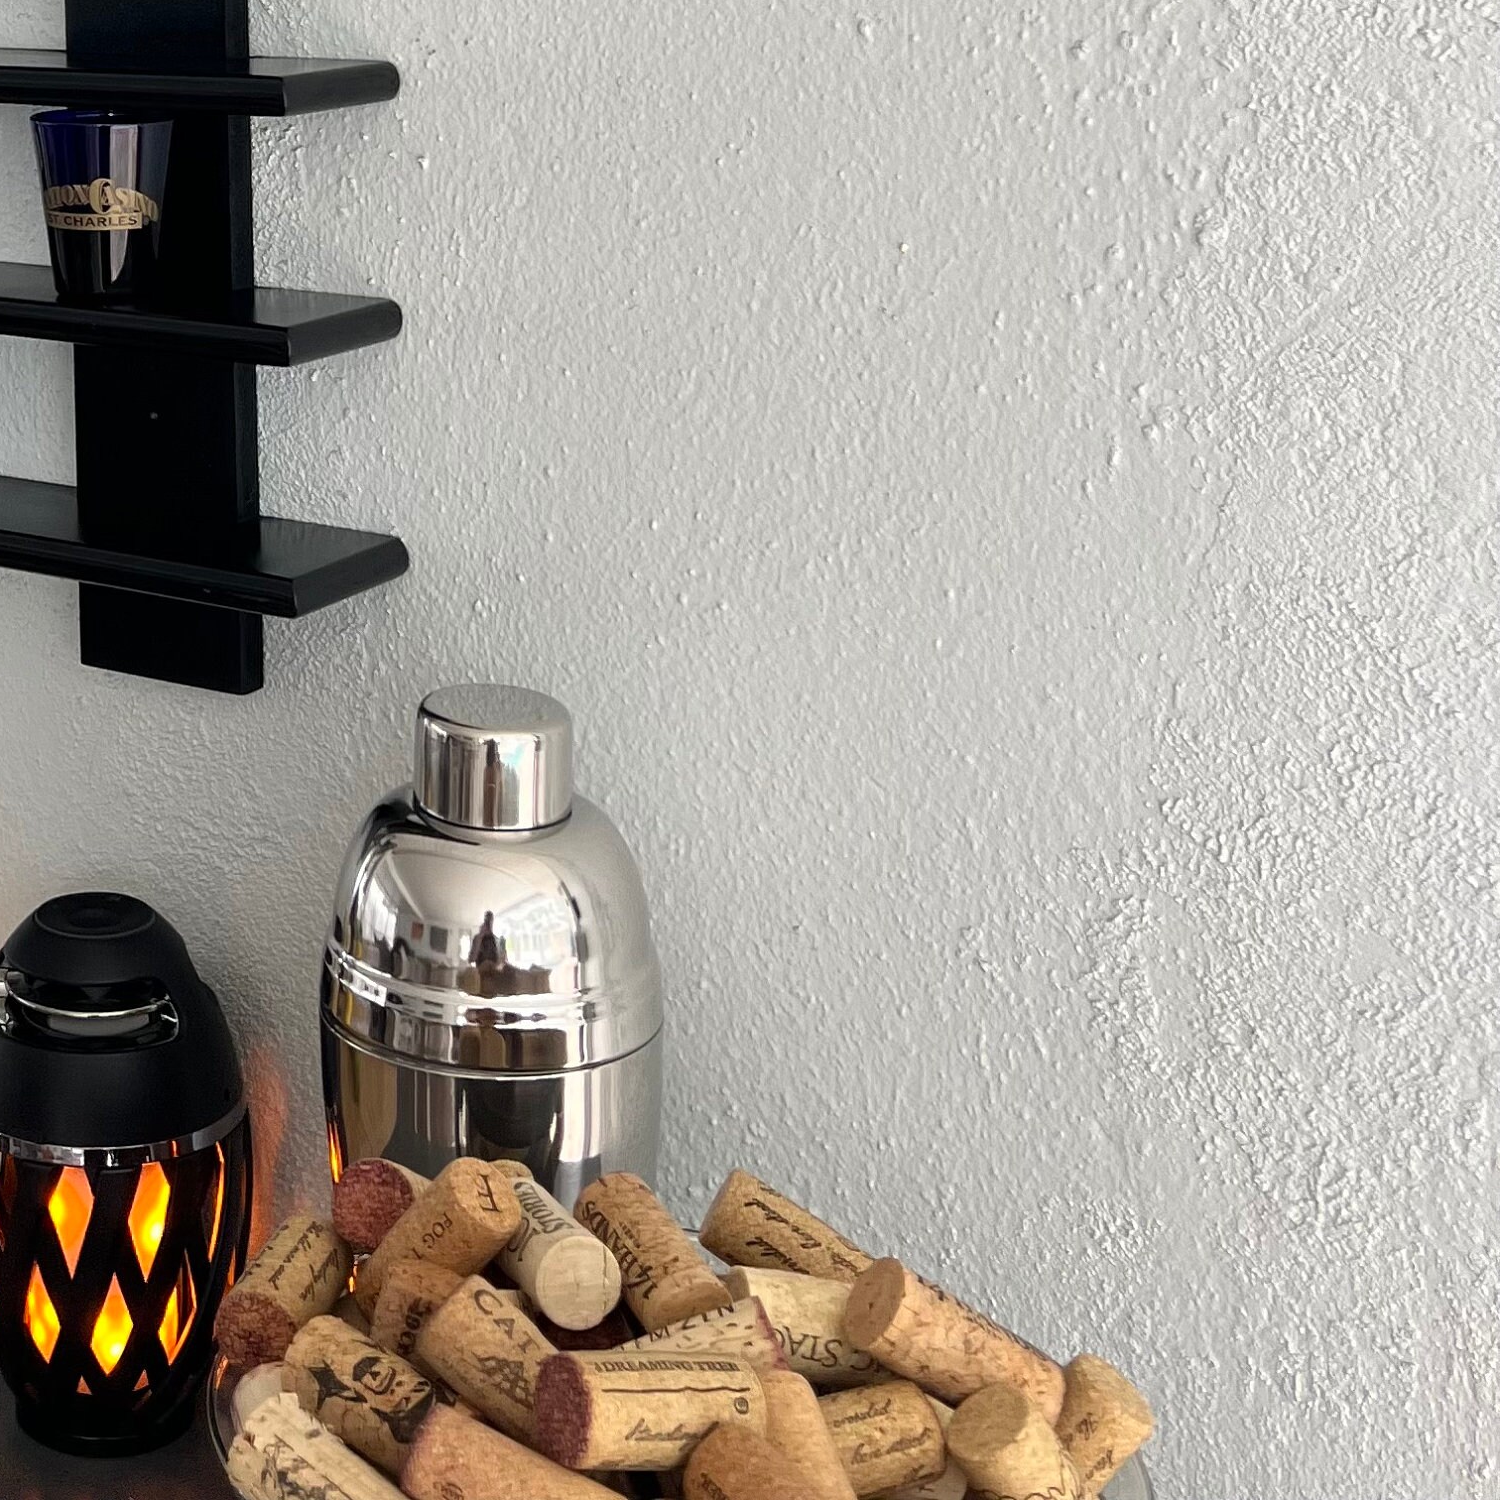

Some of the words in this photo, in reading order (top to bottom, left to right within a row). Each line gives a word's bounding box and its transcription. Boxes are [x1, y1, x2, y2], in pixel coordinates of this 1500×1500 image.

[64, 214, 138, 228] CHARLES
[422, 1211, 454, 1251] FOG
[602, 1359, 693, 1373] DREAMING
[694, 1360, 741, 1372] TREE
